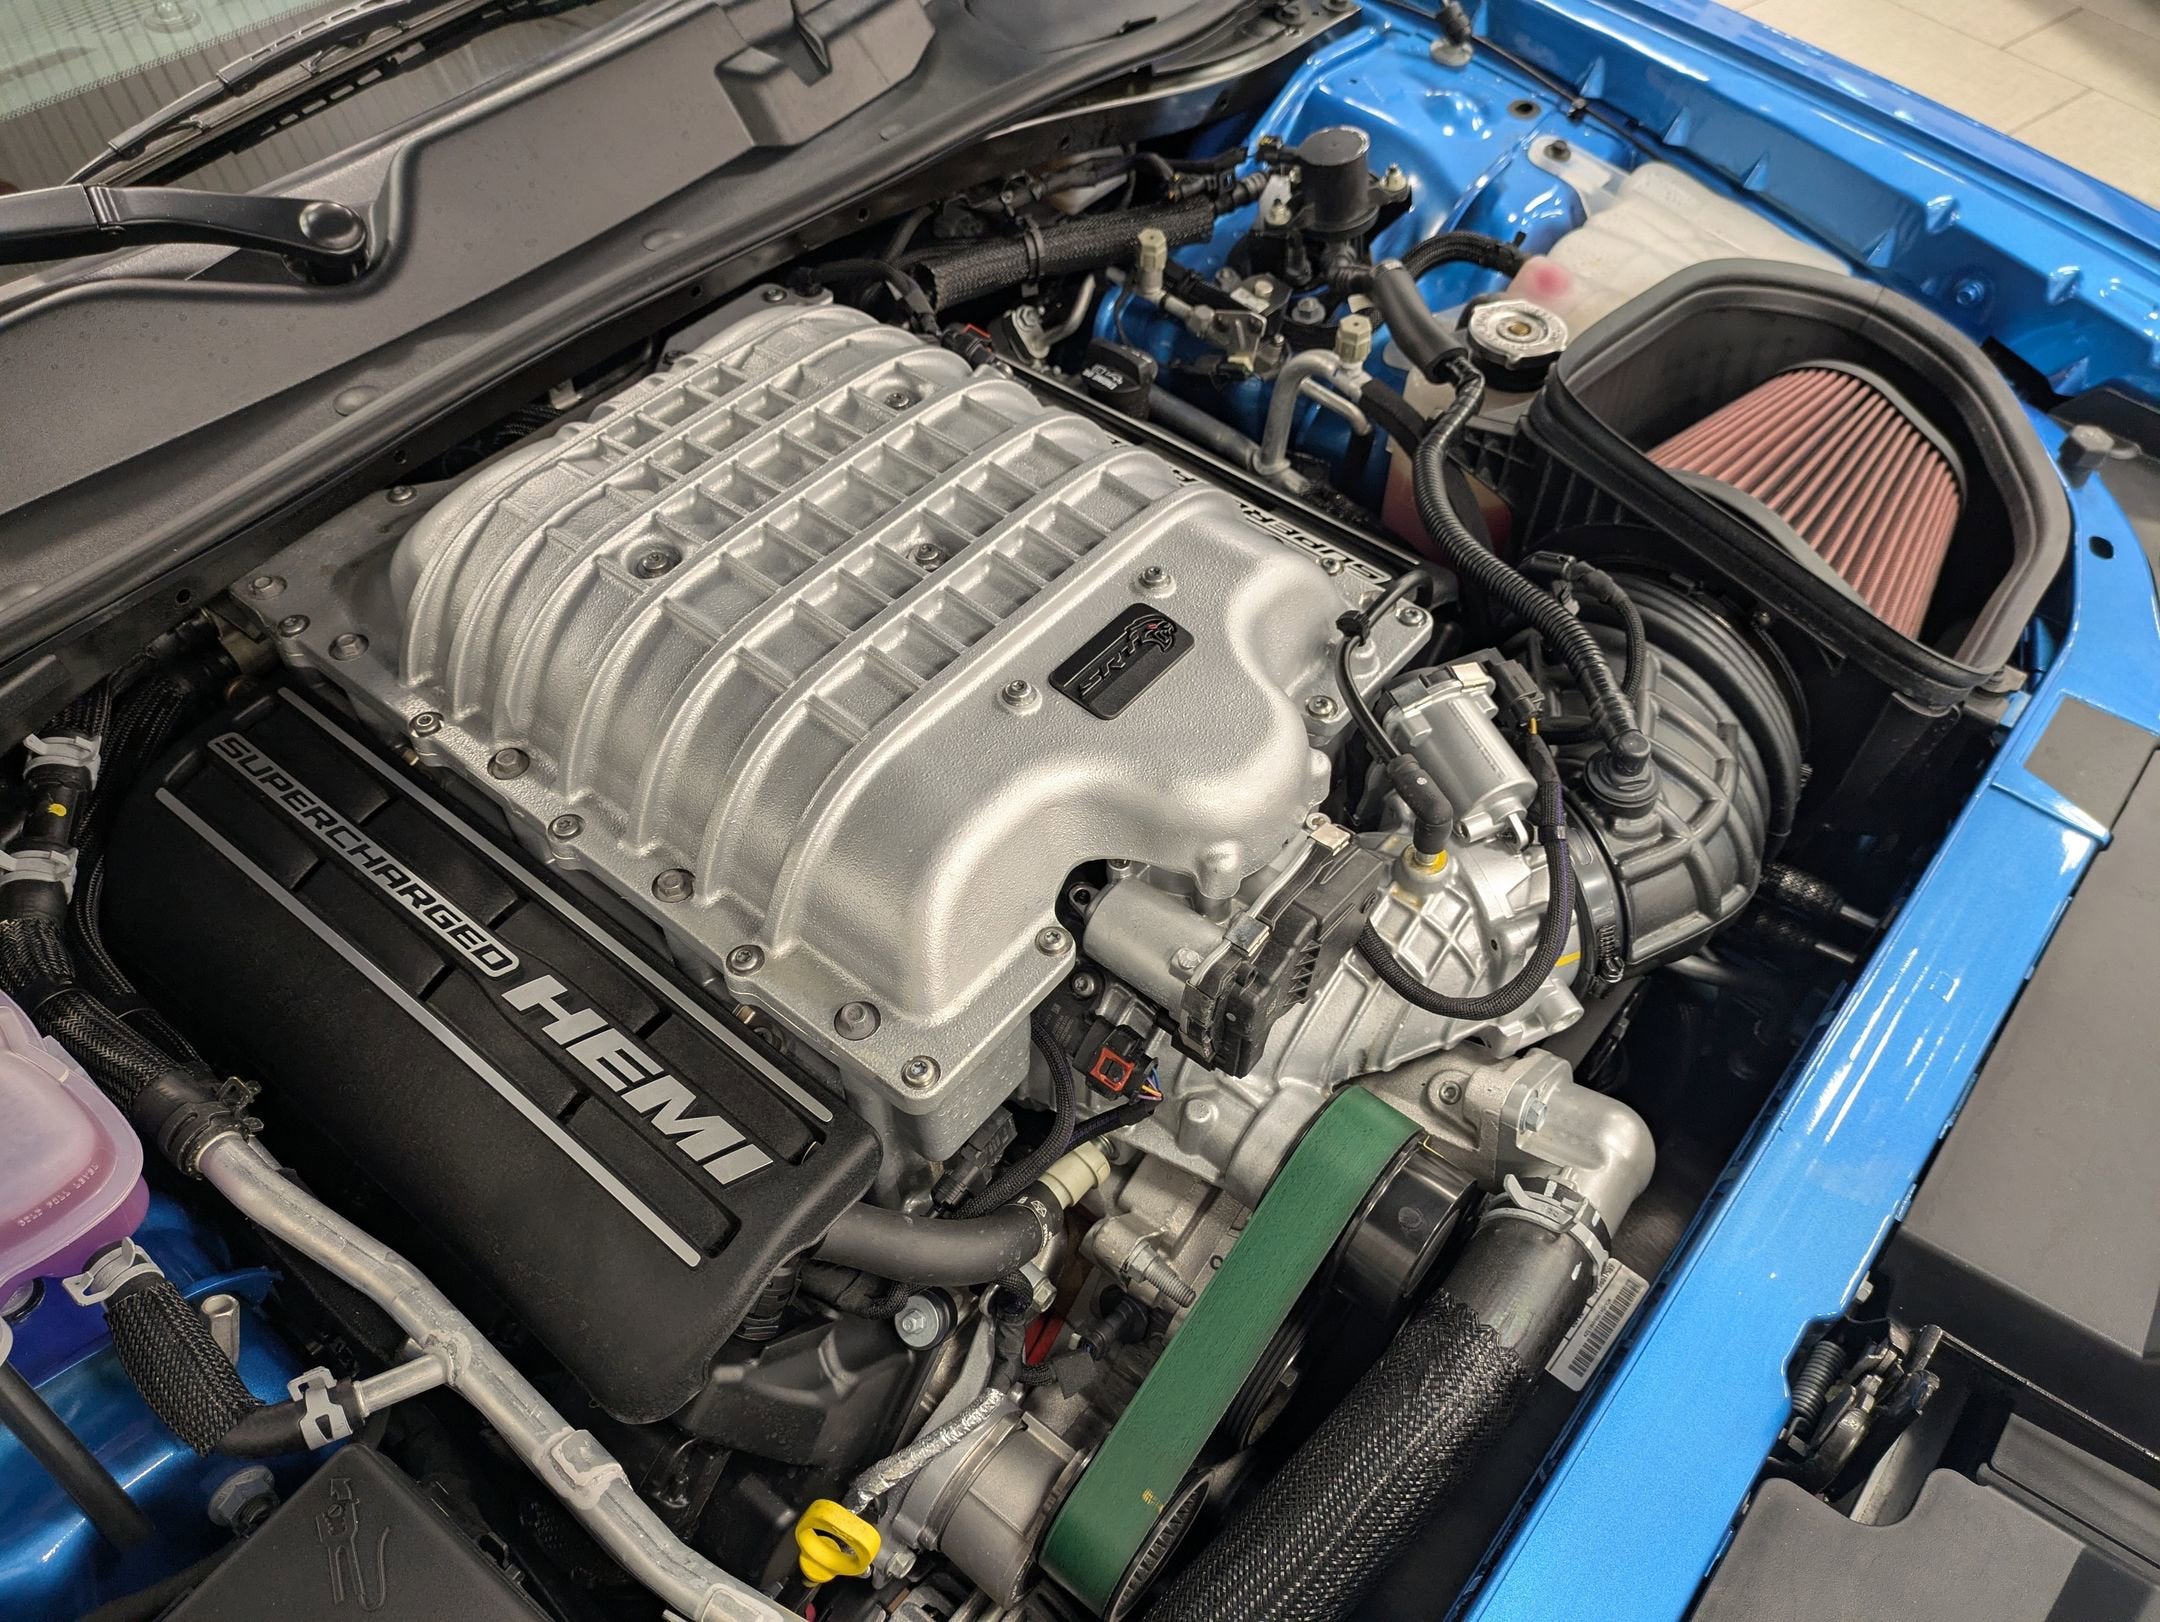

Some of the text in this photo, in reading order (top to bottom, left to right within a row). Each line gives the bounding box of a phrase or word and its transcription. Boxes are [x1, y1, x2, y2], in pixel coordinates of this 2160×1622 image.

[1079, 630, 1140, 697] SRT
[213, 736, 514, 973] SUPERCHARGED
[501, 974, 774, 1185] HEMI
